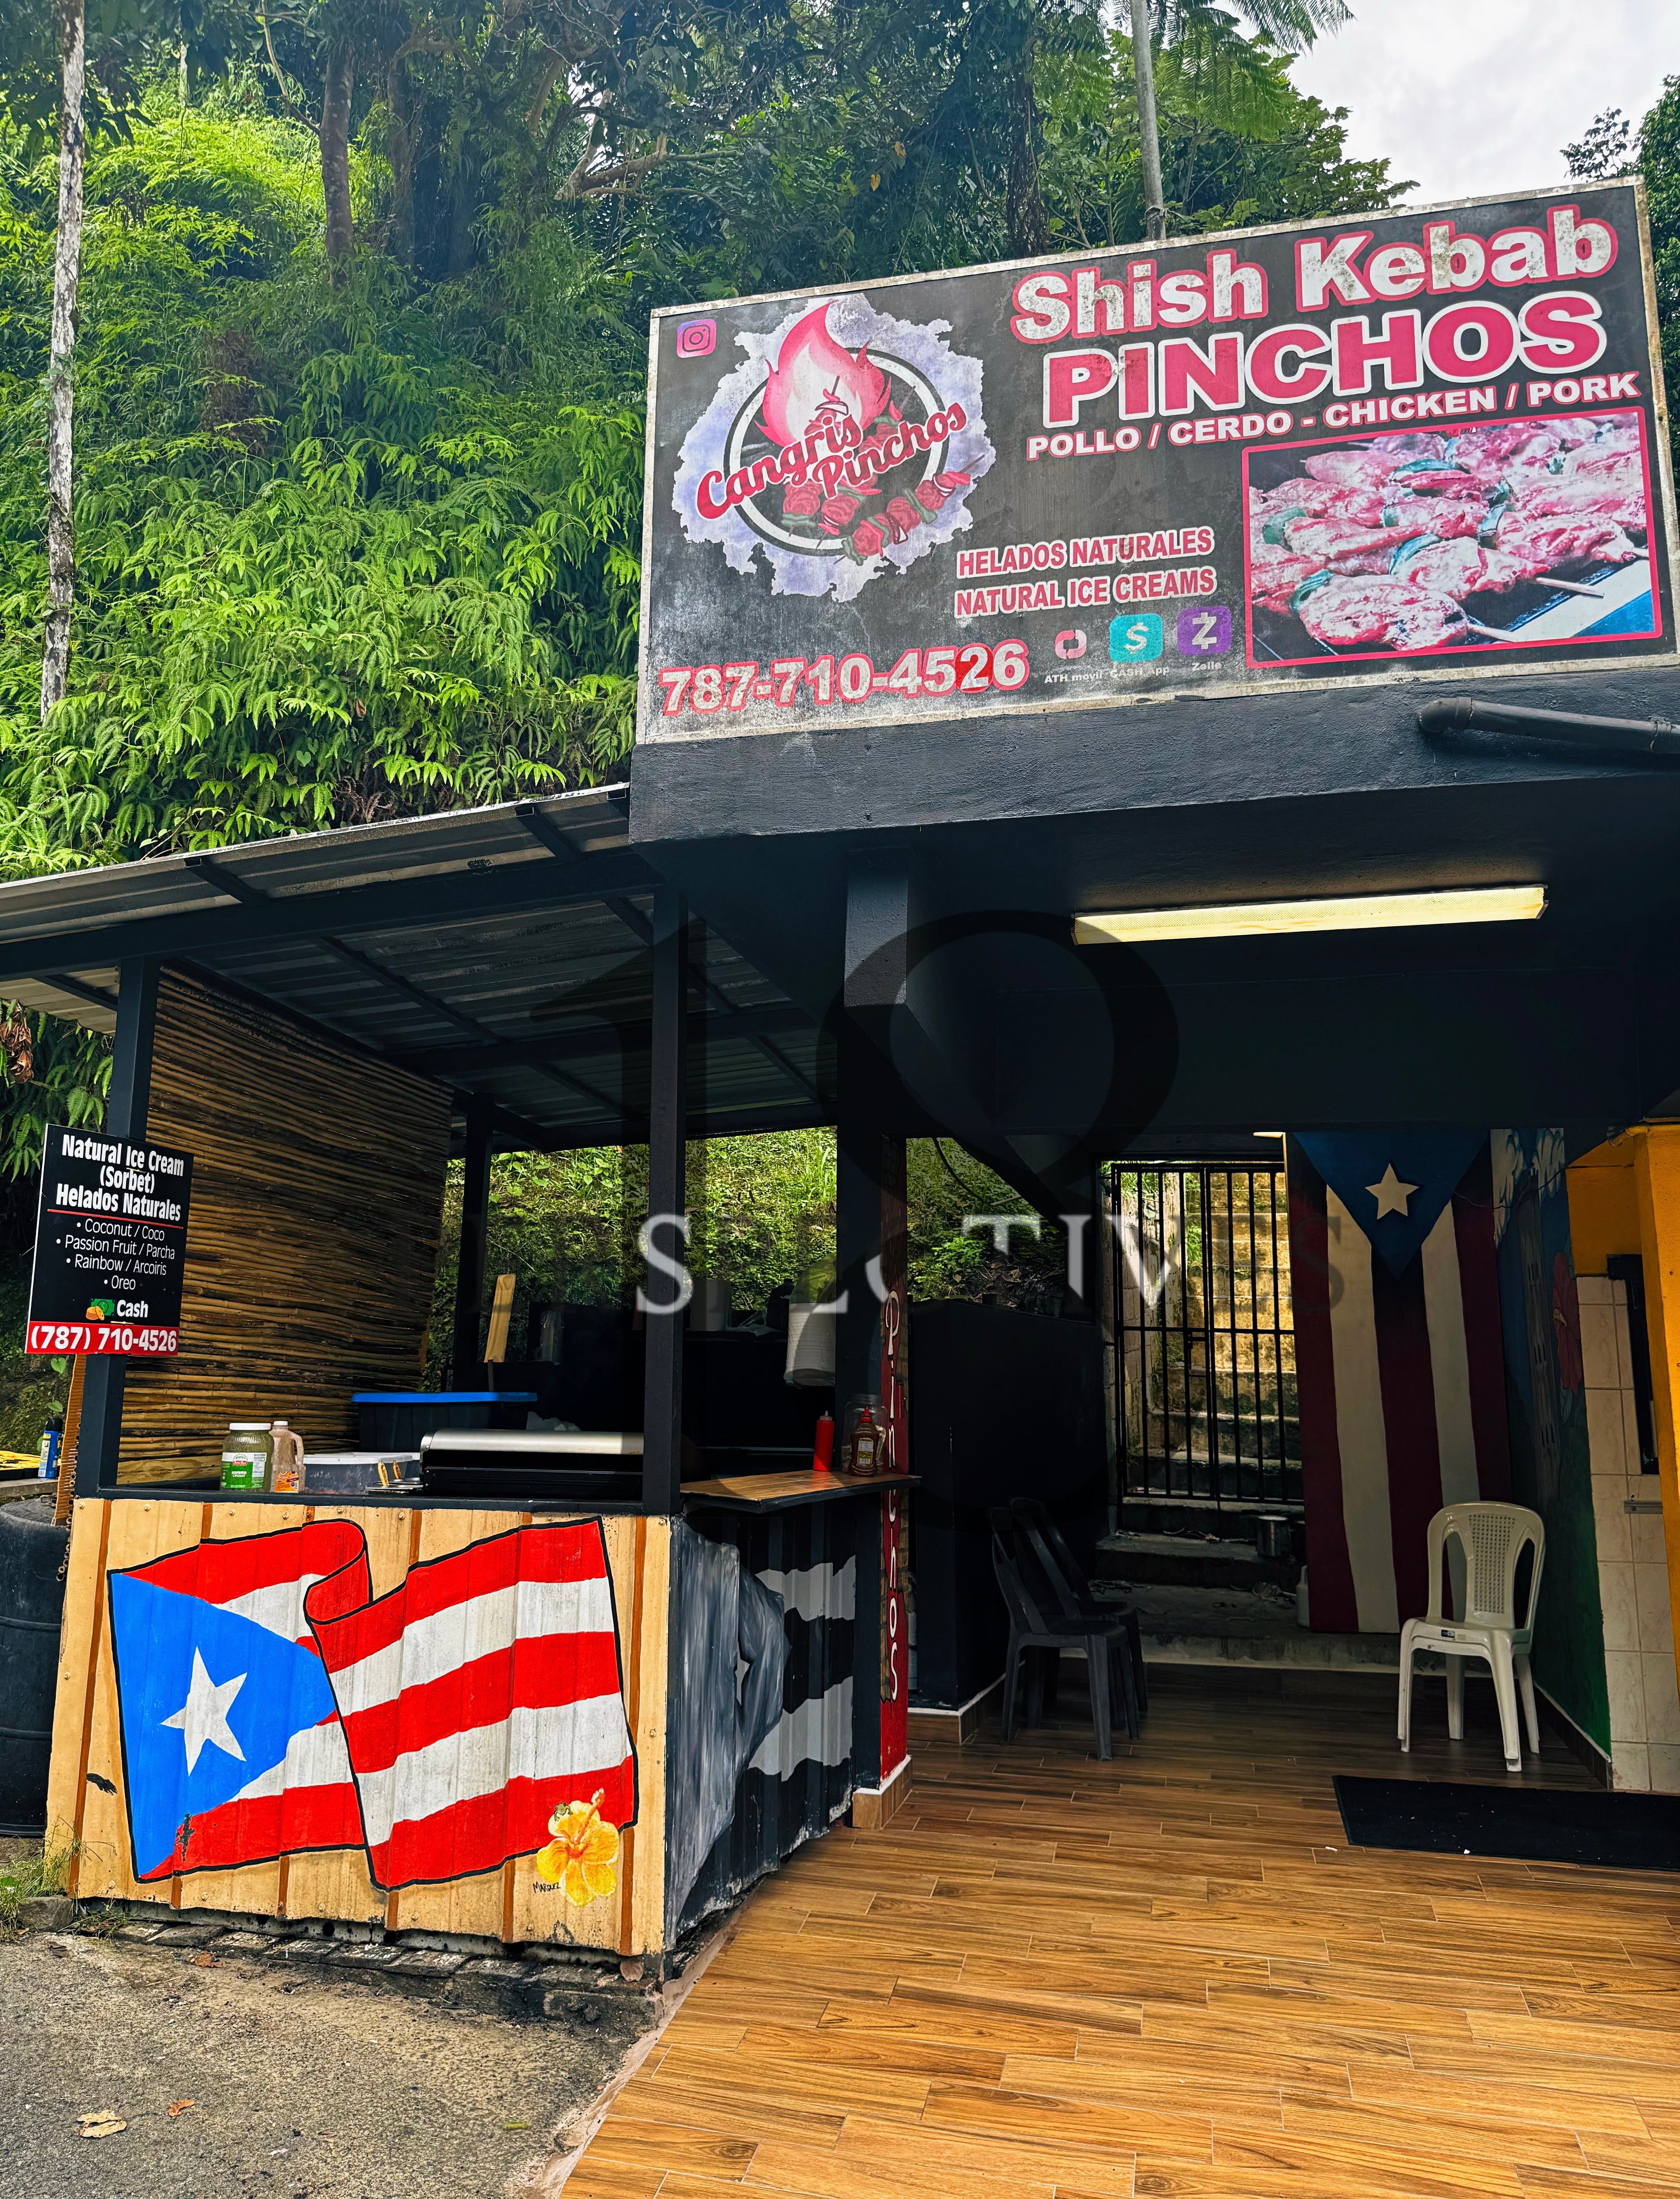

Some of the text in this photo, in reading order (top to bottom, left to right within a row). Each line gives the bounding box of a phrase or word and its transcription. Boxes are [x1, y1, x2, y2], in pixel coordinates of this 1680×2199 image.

[1011, 205, 1619, 345] Shish Kebab
[1043, 290, 1607, 428] PINCHOS
[1026, 426, 1141, 462] POLLO
[1169, 410, 1292, 447] CERDO
[1323, 386, 1497, 428] CHICKEN
[1528, 371, 1642, 408] PORK
[696, 414, 863, 519] Cangris
[813, 402, 967, 499] Pinchos
[956, 526, 1215, 579] HELADOS NATURALES
[954, 566, 1217, 619] NATURAL ICE CREAMS
[659, 638, 1029, 716] 787-710-4526
[1044, 674, 1068, 683] ATH
[1110, 667, 1142, 677] CASH
[1192, 661, 1222, 671] Zelle
[62, 1134, 184, 1176] Natural Ice Cream
[100, 1165, 155, 1193] (Sorbet)
[56, 1183, 181, 1221] Helados Naturales
[85, 1219, 132, 1237] Coconut
[142, 1226, 164, 1241] Coco
[65, 1235, 109, 1253] Passion
[113, 1240, 137, 1255] Fruit
[147, 1246, 175, 1259] Parcha
[75, 1254, 123, 1271] Rainbow
[133, 1260, 166, 1275] Arcoiris
[111, 1275, 136, 1290] Oreo
[116, 1299, 148, 1318] Cash
[31, 1325, 176, 1351] (787) 710-4526
